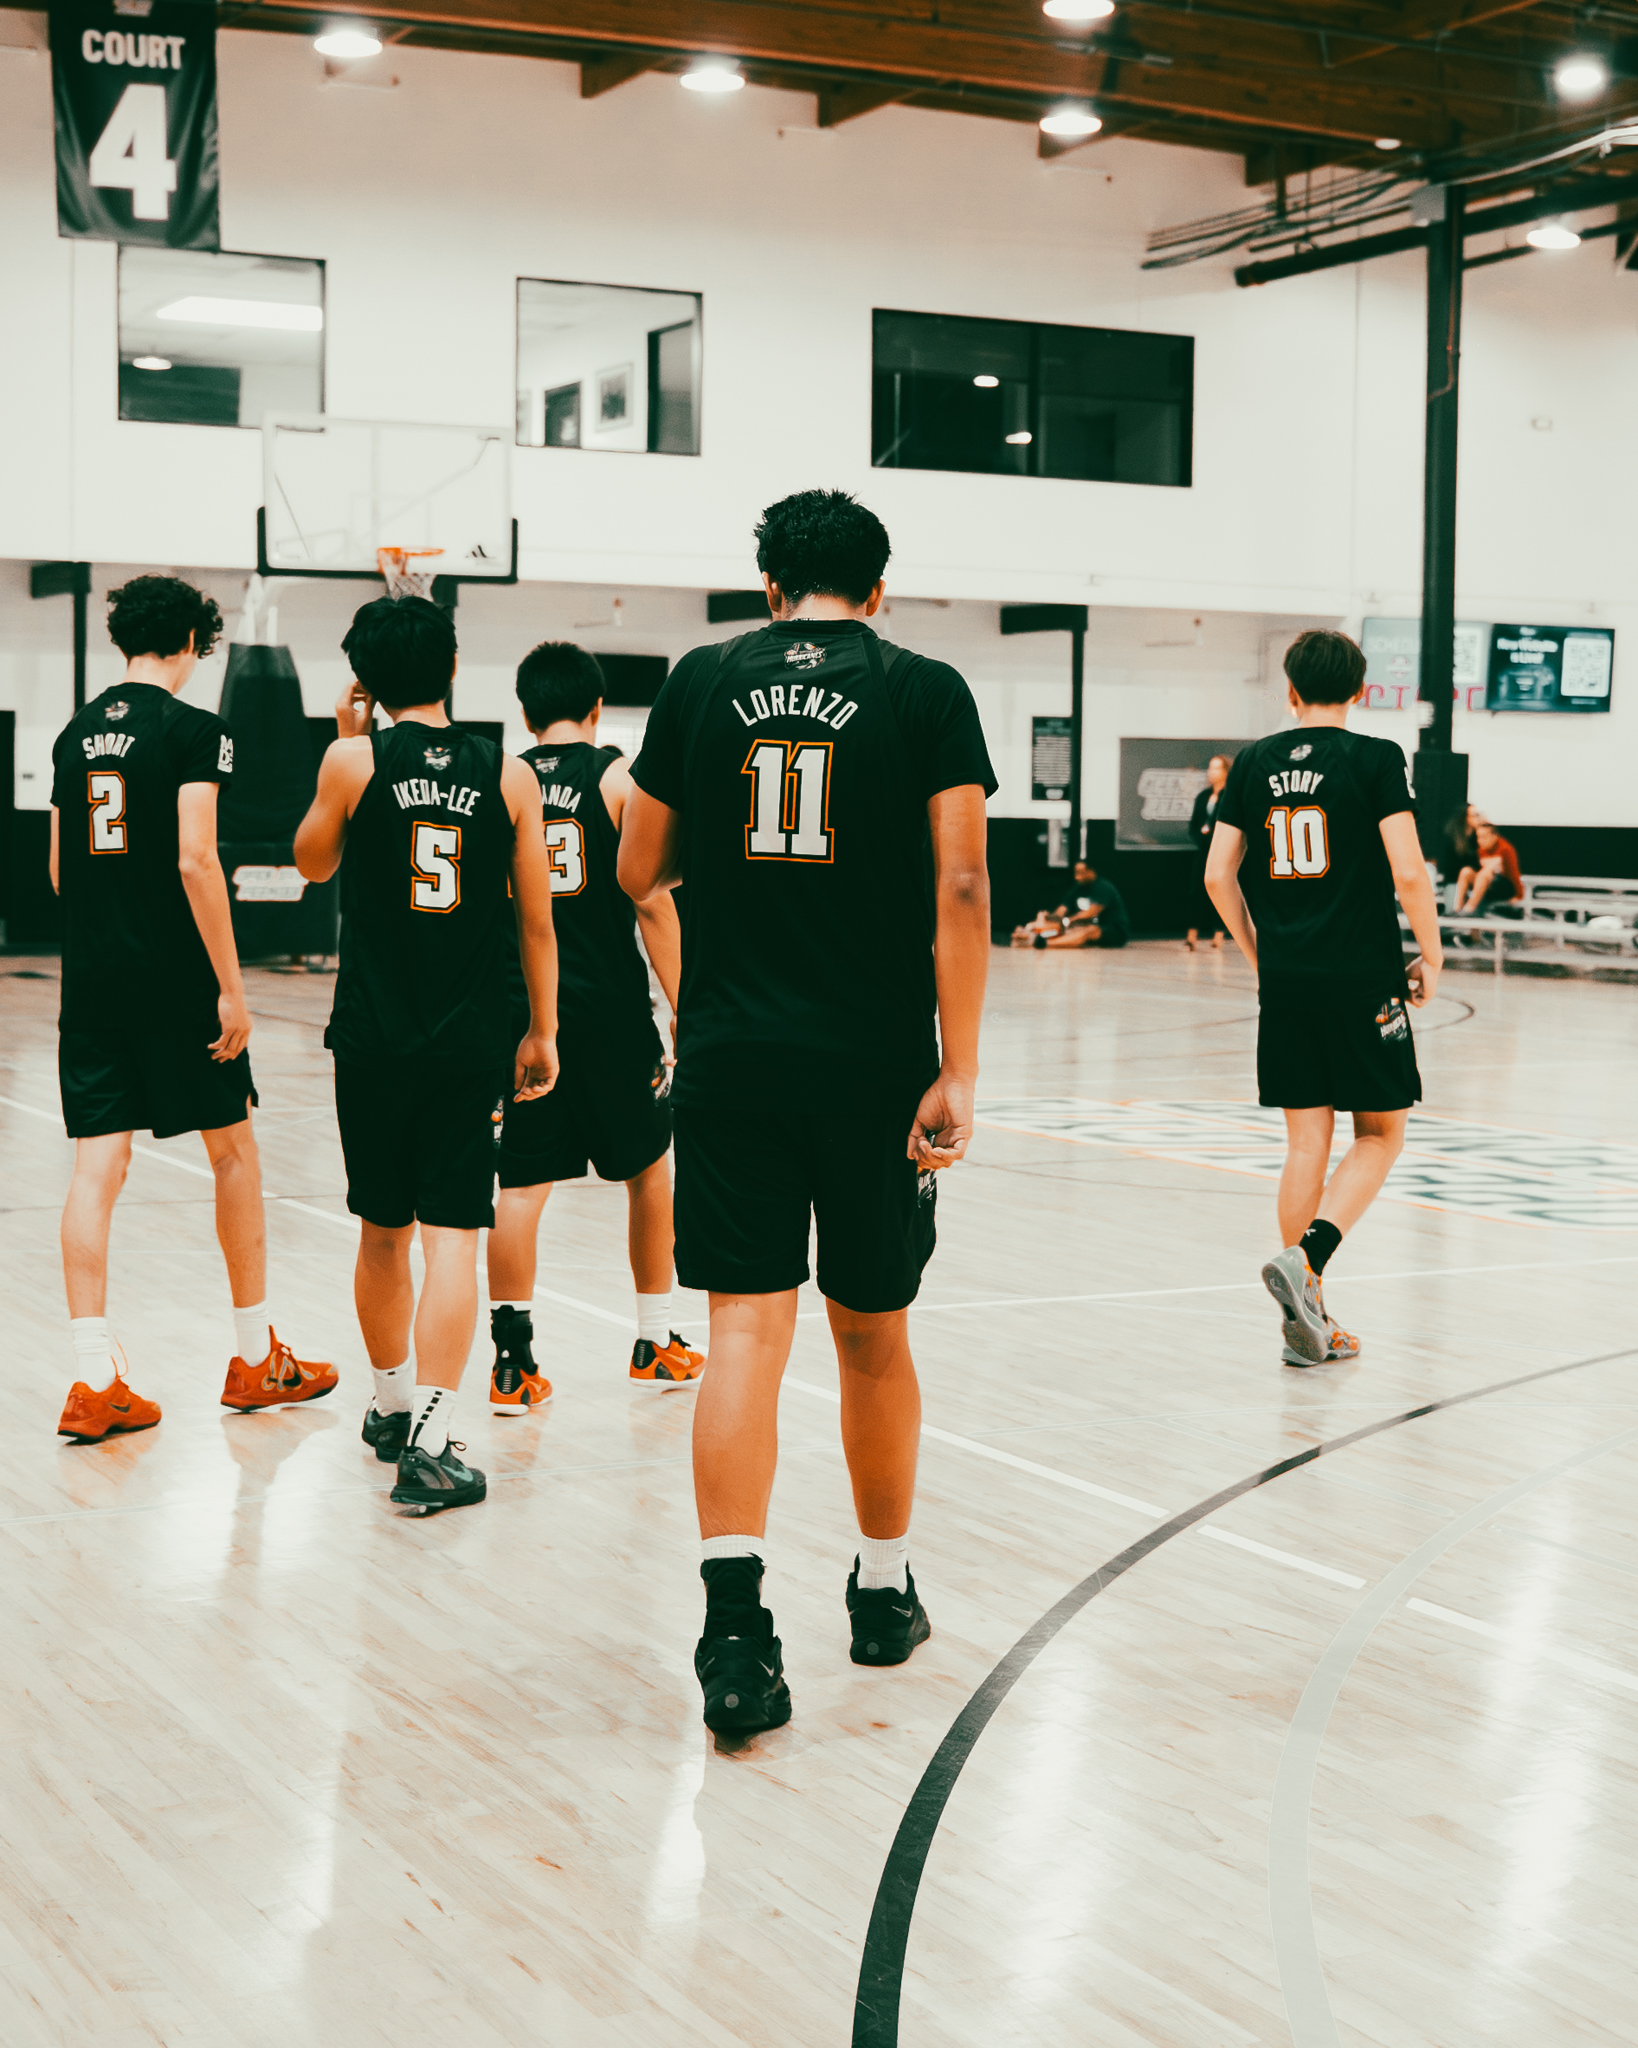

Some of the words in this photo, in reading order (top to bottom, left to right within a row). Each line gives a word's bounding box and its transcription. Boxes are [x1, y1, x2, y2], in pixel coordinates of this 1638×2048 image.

[82, 29, 186, 70] COURT
[89, 83, 177, 221] 4
[732, 684, 859, 730] LORENZO
[82, 732, 136, 760] SHORT
[87, 770, 128, 855] 2
[392, 778, 482, 816] IKEDA-LEE
[541, 783, 582, 813] ANDA
[740, 738, 835, 864] 11
[1268, 769, 1324, 798] STORY
[410, 820, 462, 914] 5
[542, 817, 588, 898] 3
[1264, 805, 1331, 879] 10
